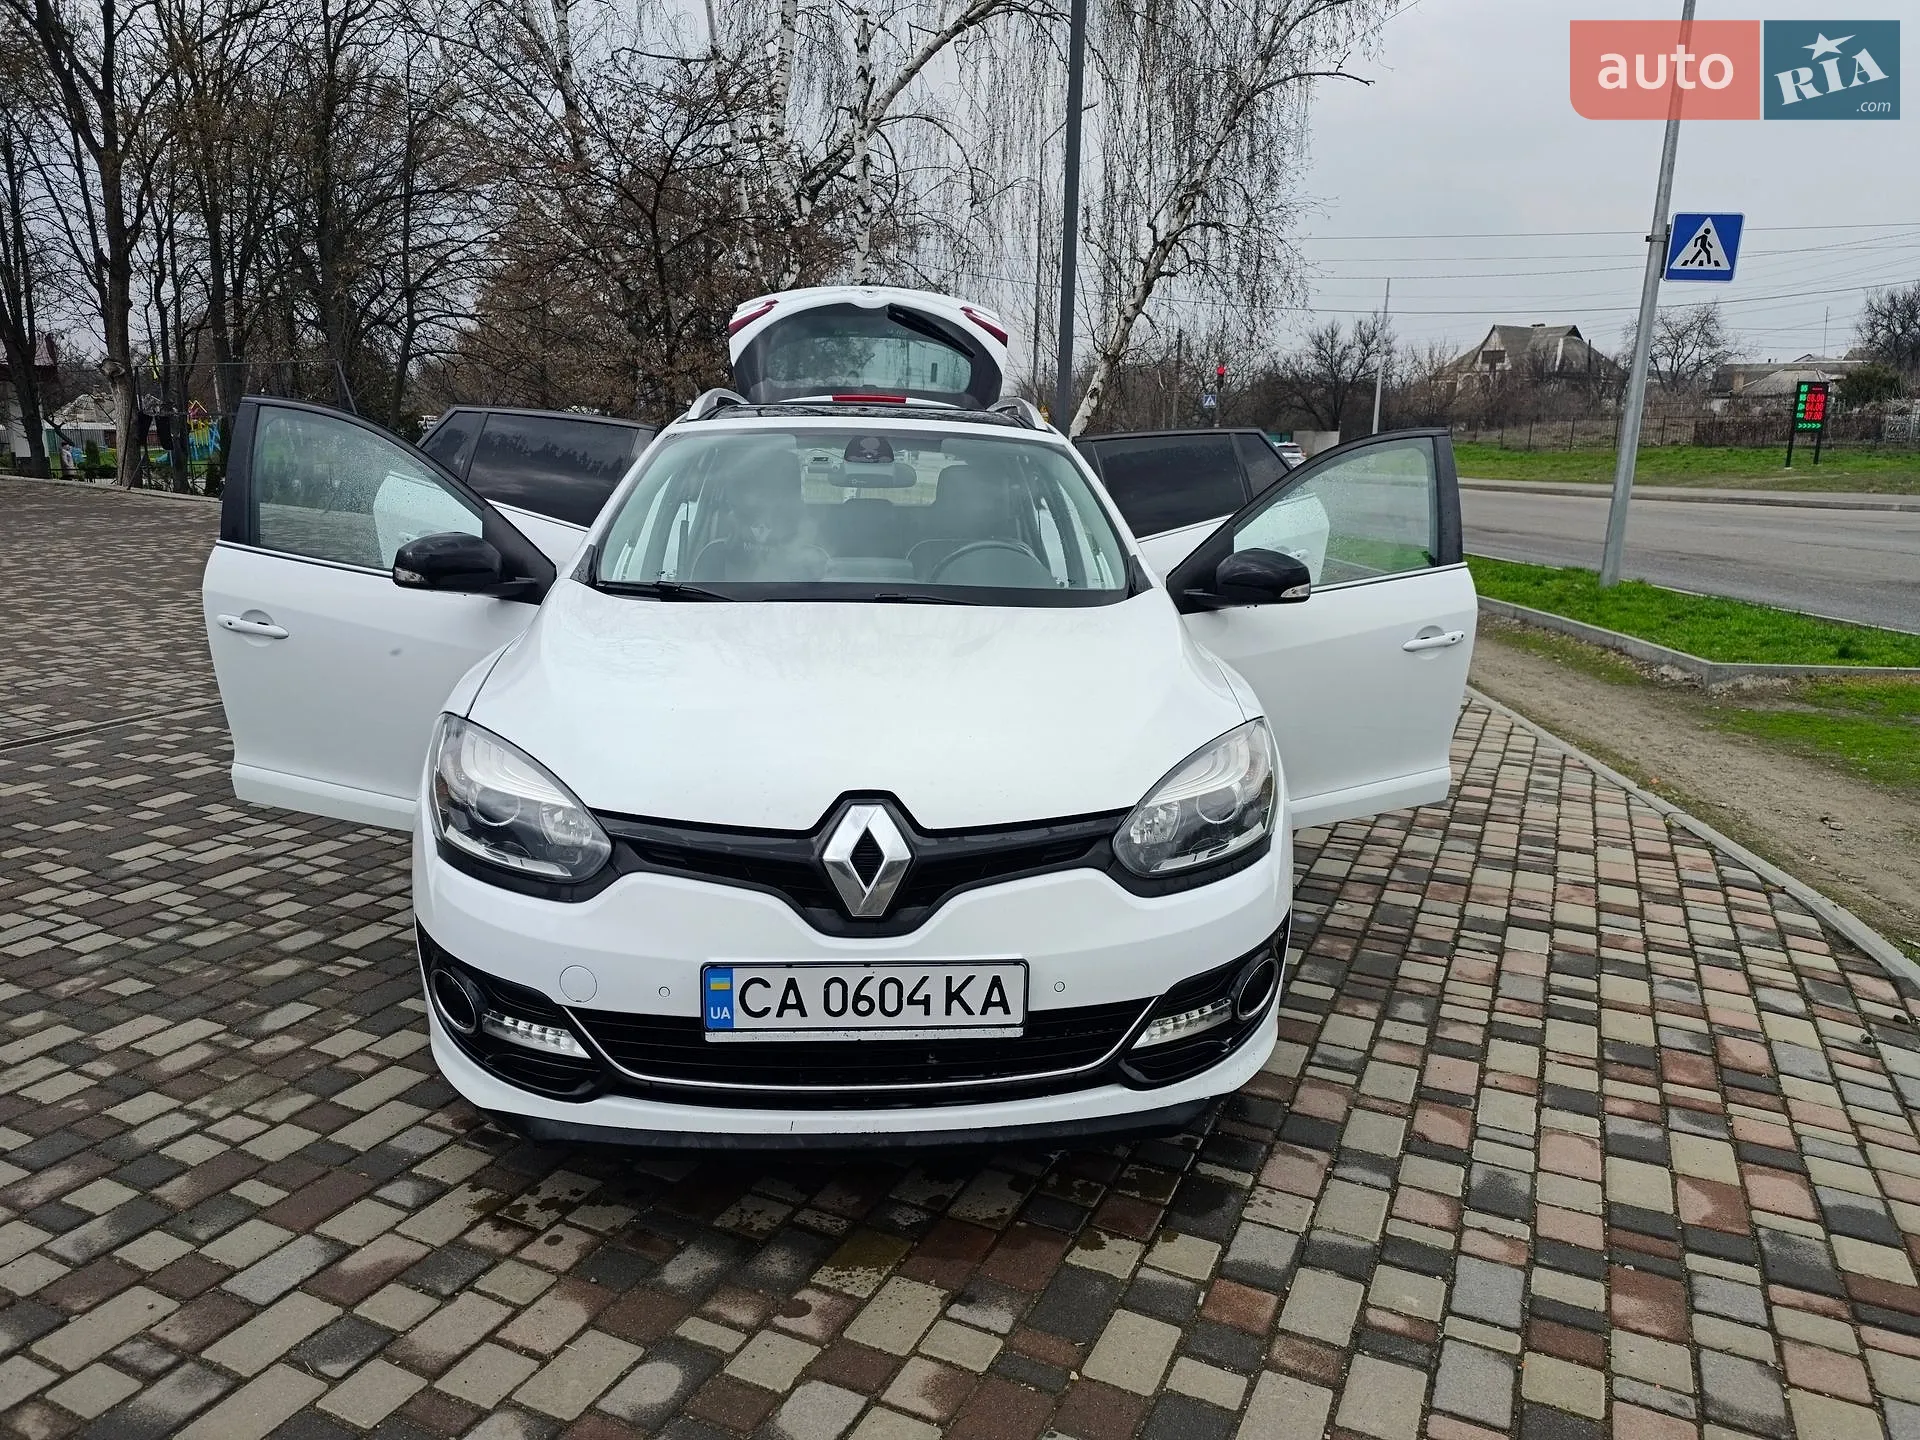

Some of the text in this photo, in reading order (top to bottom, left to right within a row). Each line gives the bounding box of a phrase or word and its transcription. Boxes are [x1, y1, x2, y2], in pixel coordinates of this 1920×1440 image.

[738, 974, 1012, 1018] CA 0604 KA
[710, 1006, 731, 1020] UA
